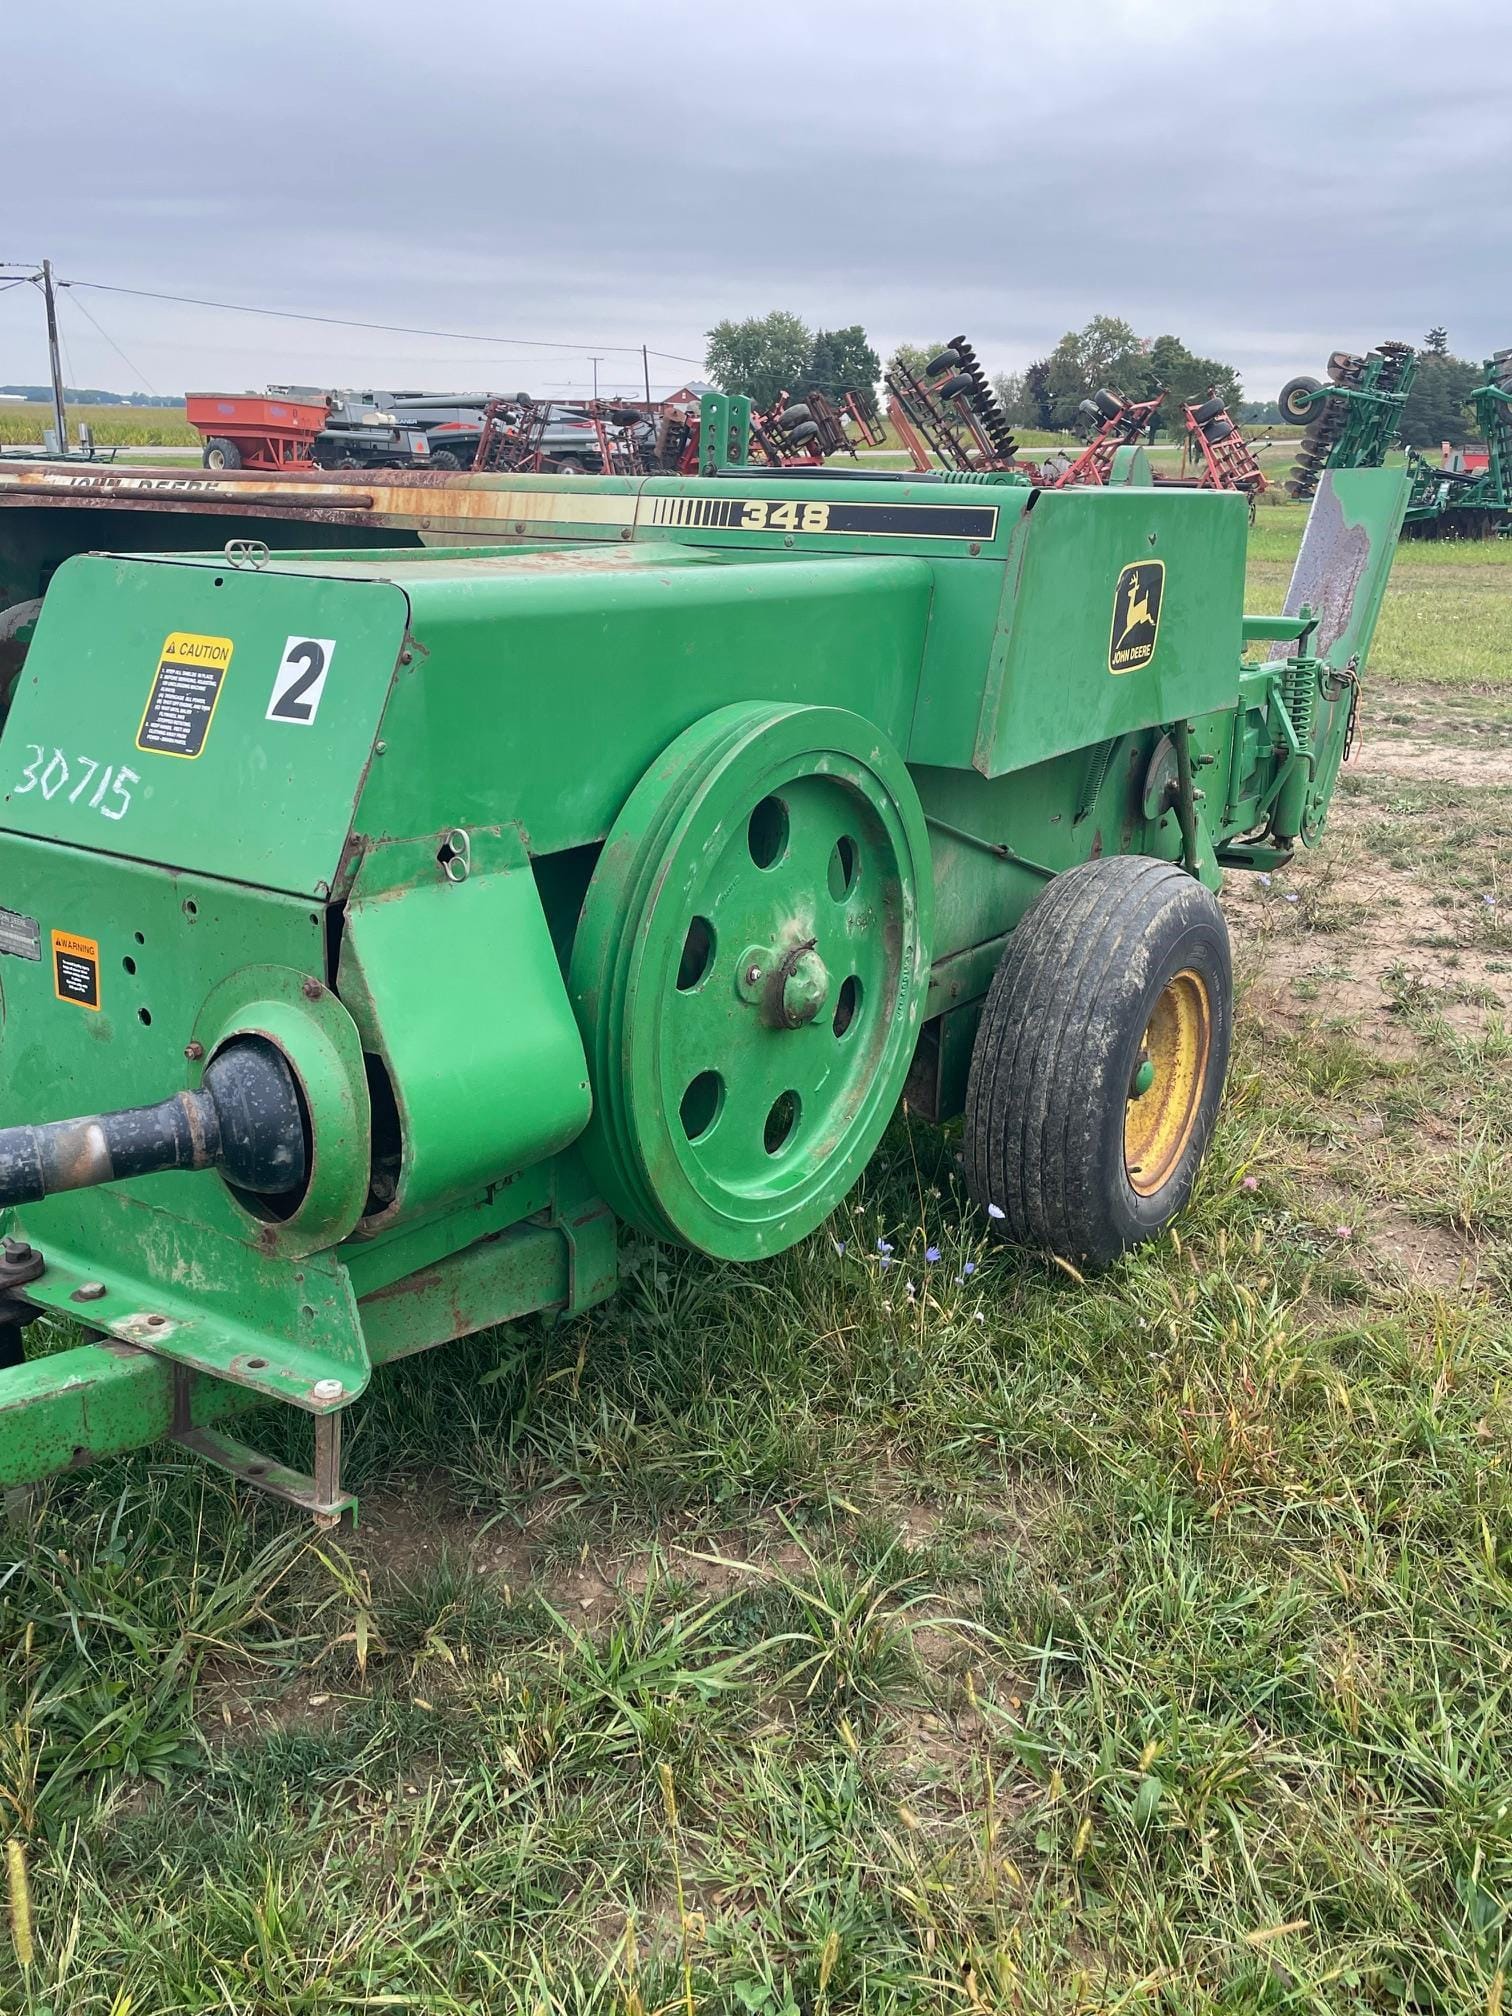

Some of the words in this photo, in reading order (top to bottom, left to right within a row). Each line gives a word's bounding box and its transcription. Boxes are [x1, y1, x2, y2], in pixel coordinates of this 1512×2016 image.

[741, 500, 830, 532] 348
[179, 642, 229, 660] CAUTION
[1112, 648, 1131, 665] JOHN
[1130, 643, 1152, 661] DEERE
[272, 641, 325, 720] 2
[14, 744, 142, 820] 30715
[61, 940, 95, 955] WARNING
